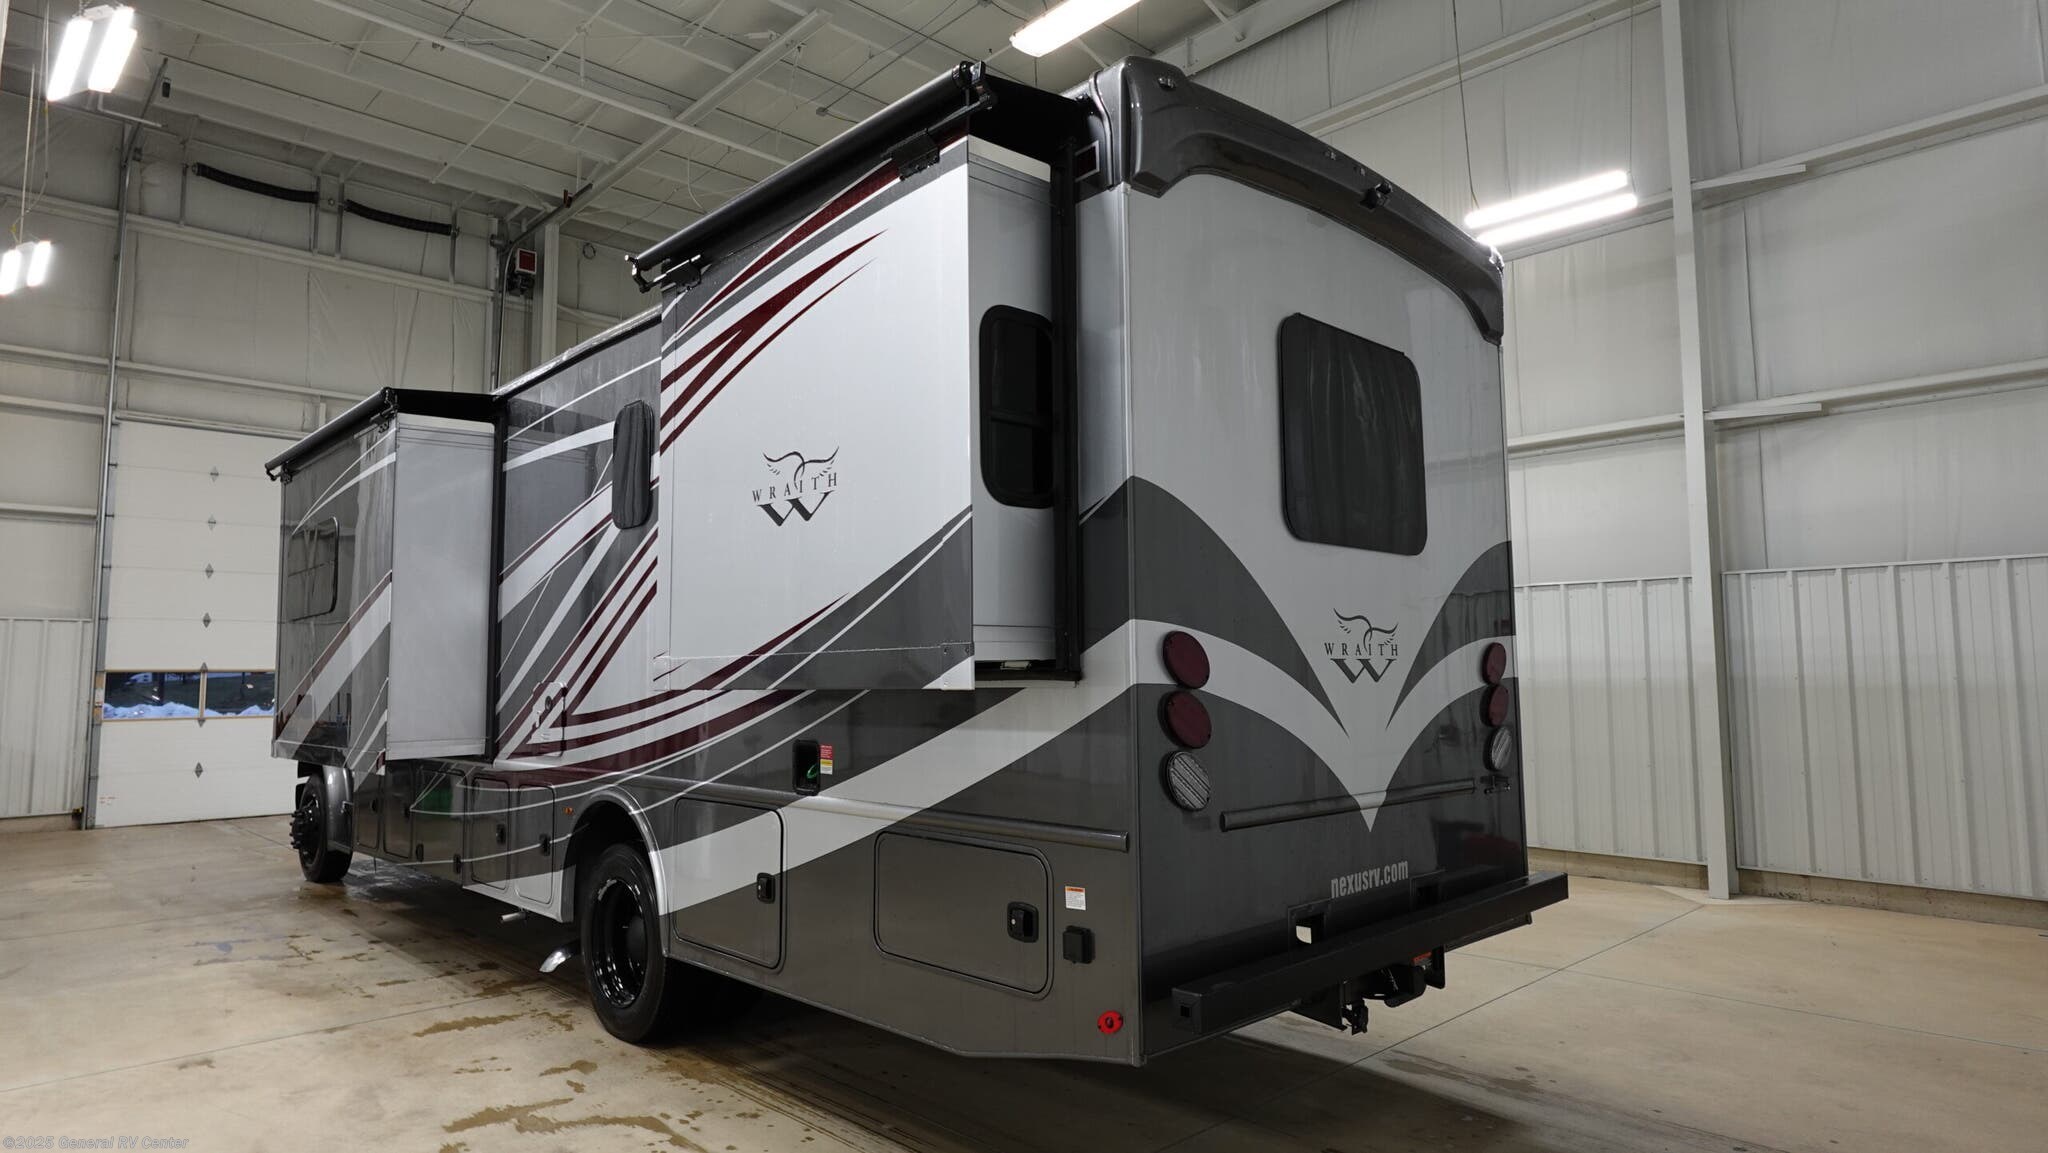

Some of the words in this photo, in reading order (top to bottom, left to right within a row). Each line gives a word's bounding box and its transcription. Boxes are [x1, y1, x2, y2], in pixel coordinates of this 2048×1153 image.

[752, 472, 837, 502] WRAITH
[1324, 642, 1399, 656] WRAITH
[1330, 860, 1409, 899] nexusrv.com
